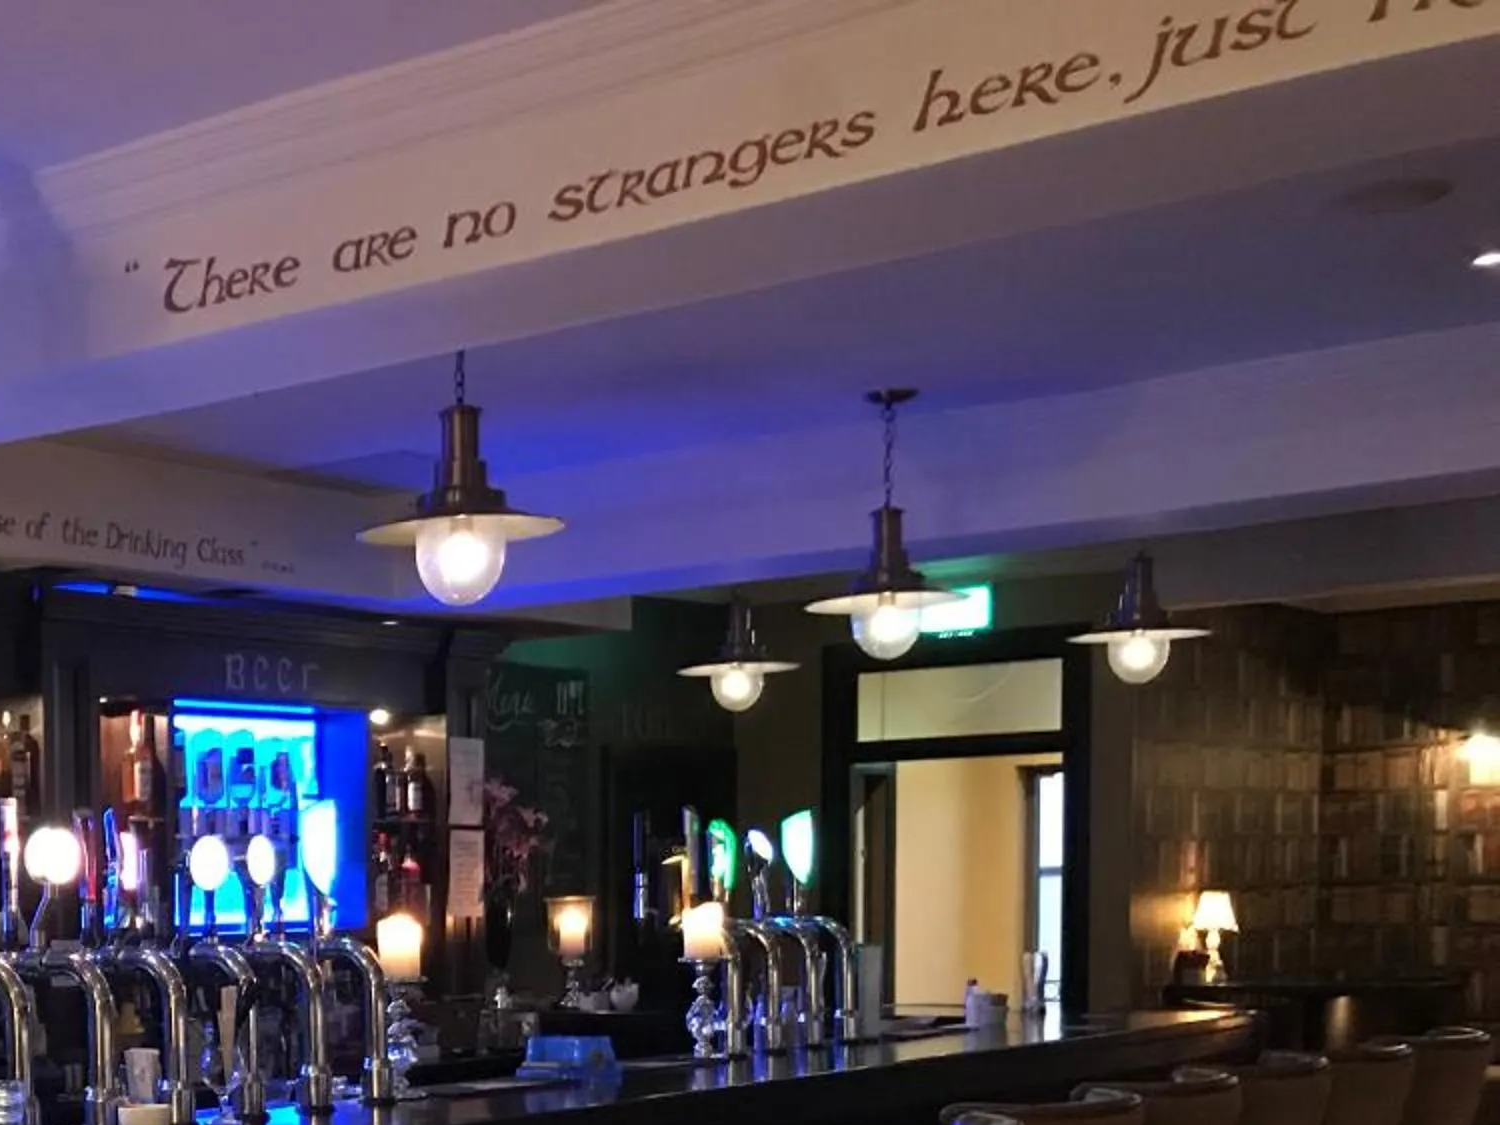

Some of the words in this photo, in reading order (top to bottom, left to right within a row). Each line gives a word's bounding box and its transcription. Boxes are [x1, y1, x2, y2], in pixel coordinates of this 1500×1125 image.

[332, 226, 418, 273] are
[442, 201, 516, 248] no
[547, 109, 877, 222] strangers
[25, 513, 51, 541] of
[60, 514, 100, 549] the
[105, 520, 189, 570] Drinking
[224, 652, 320, 693] Beer
